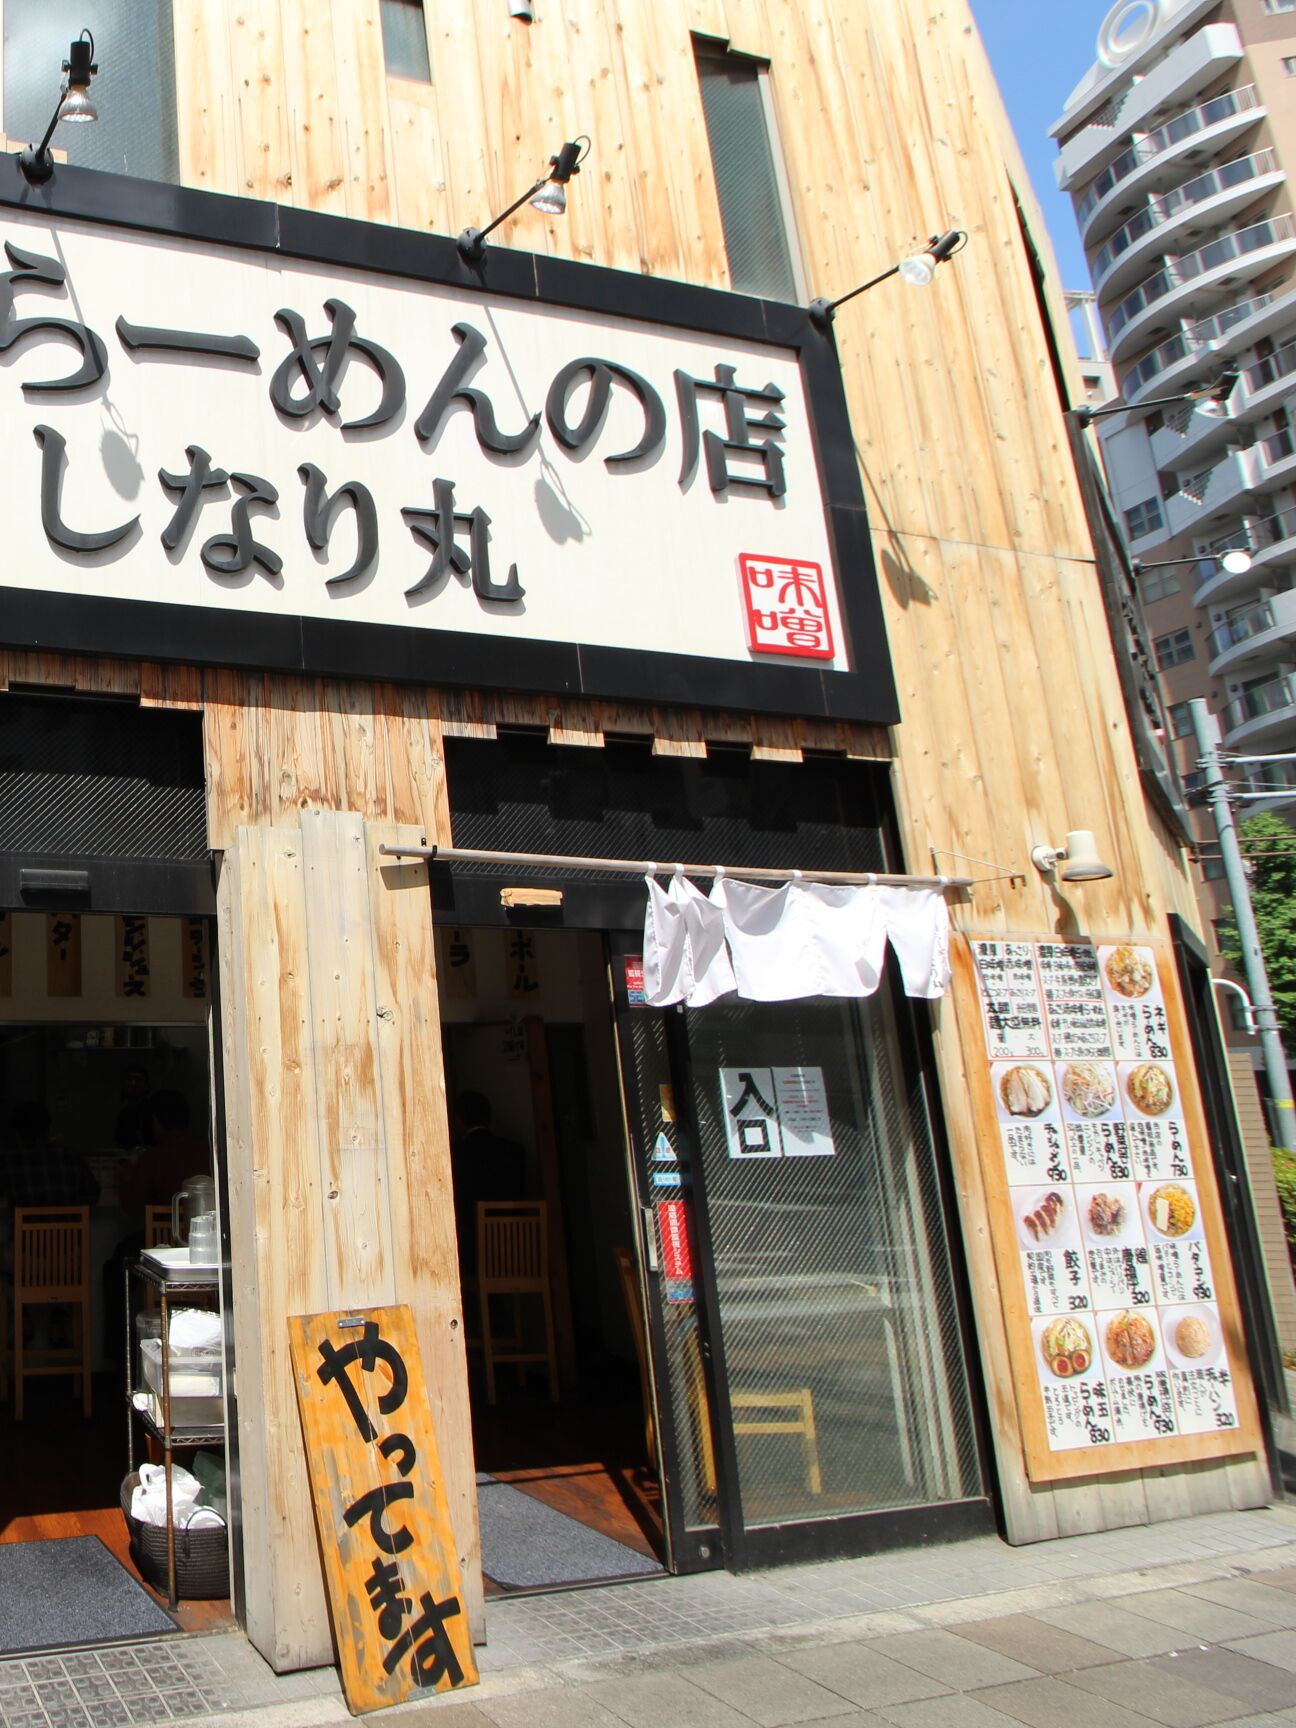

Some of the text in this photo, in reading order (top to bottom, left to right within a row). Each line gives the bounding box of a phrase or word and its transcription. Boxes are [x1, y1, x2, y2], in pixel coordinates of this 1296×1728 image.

[31, 422, 527, 610] しなり丸
[748, 565, 826, 650] 味噌
[1142, 1004, 1157, 1045] らーめん
[1150, 1045, 1168, 1058] 830
[729, 1072, 774, 1154] 入口
[1101, 1123, 1118, 1164] らーめん
[1168, 1121, 1184, 1162] らーめん
[1047, 1167, 1067, 1181] 930
[1110, 1165, 1129, 1179] 830
[1170, 1164, 1188, 1176] 730
[1068, 1295, 1088, 1310] 320
[1131, 1291, 1150, 1304] 320
[1080, 1382, 1097, 1429] らーめん
[1144, 1374, 1161, 1419] らーめん
[1089, 1428, 1110, 1443] 830
[1154, 1418, 1174, 1435] 930
[316, 1321, 464, 1689] やってます
